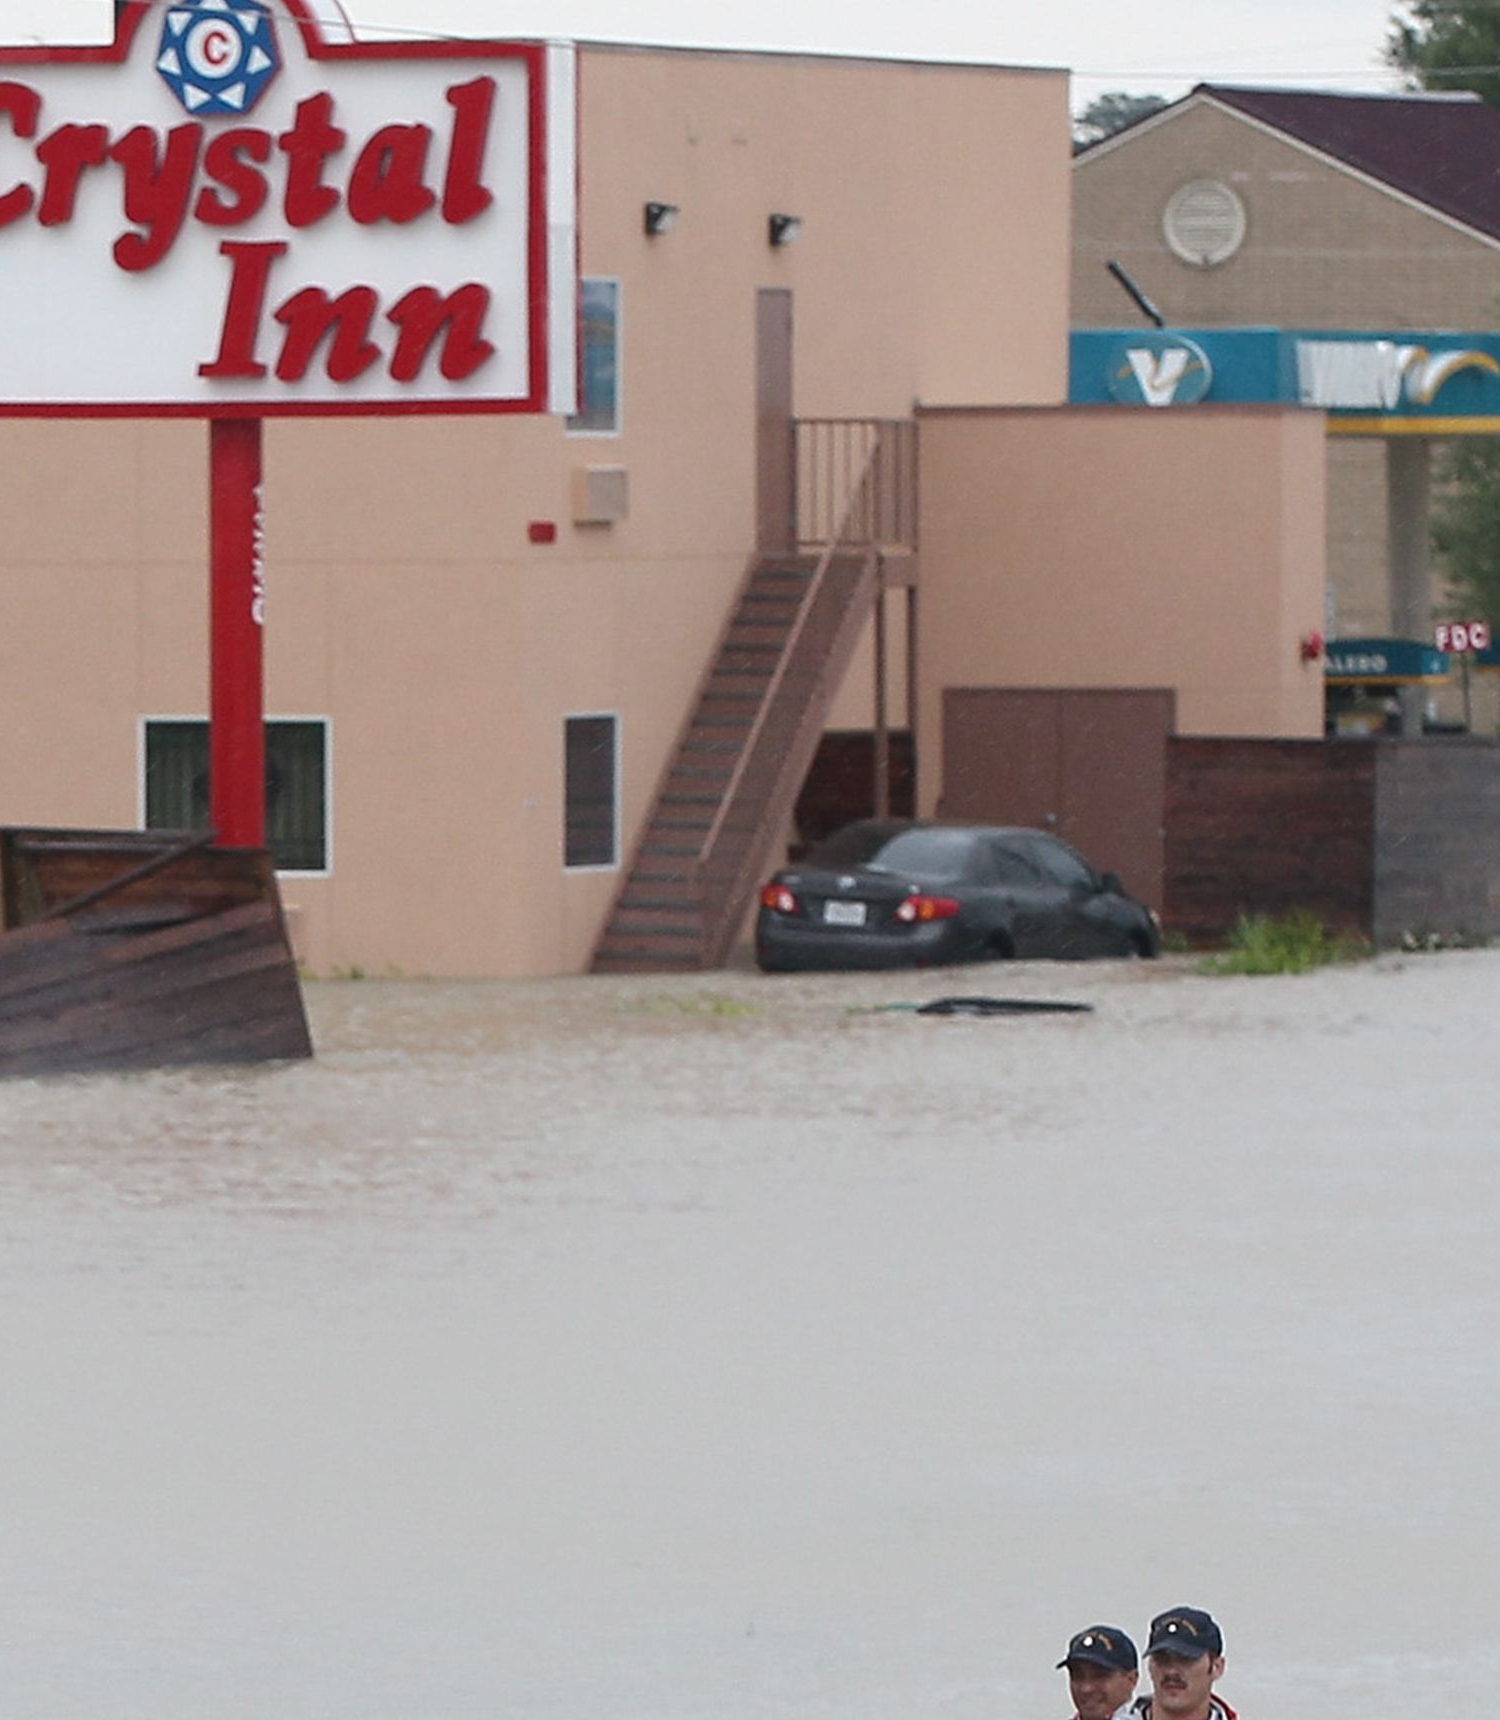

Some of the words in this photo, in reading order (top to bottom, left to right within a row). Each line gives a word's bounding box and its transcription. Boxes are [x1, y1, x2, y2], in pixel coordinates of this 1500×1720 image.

[203, 31, 227, 65] C
[197, 240, 495, 382] Inn
[1434, 622, 1489, 652] FDC
